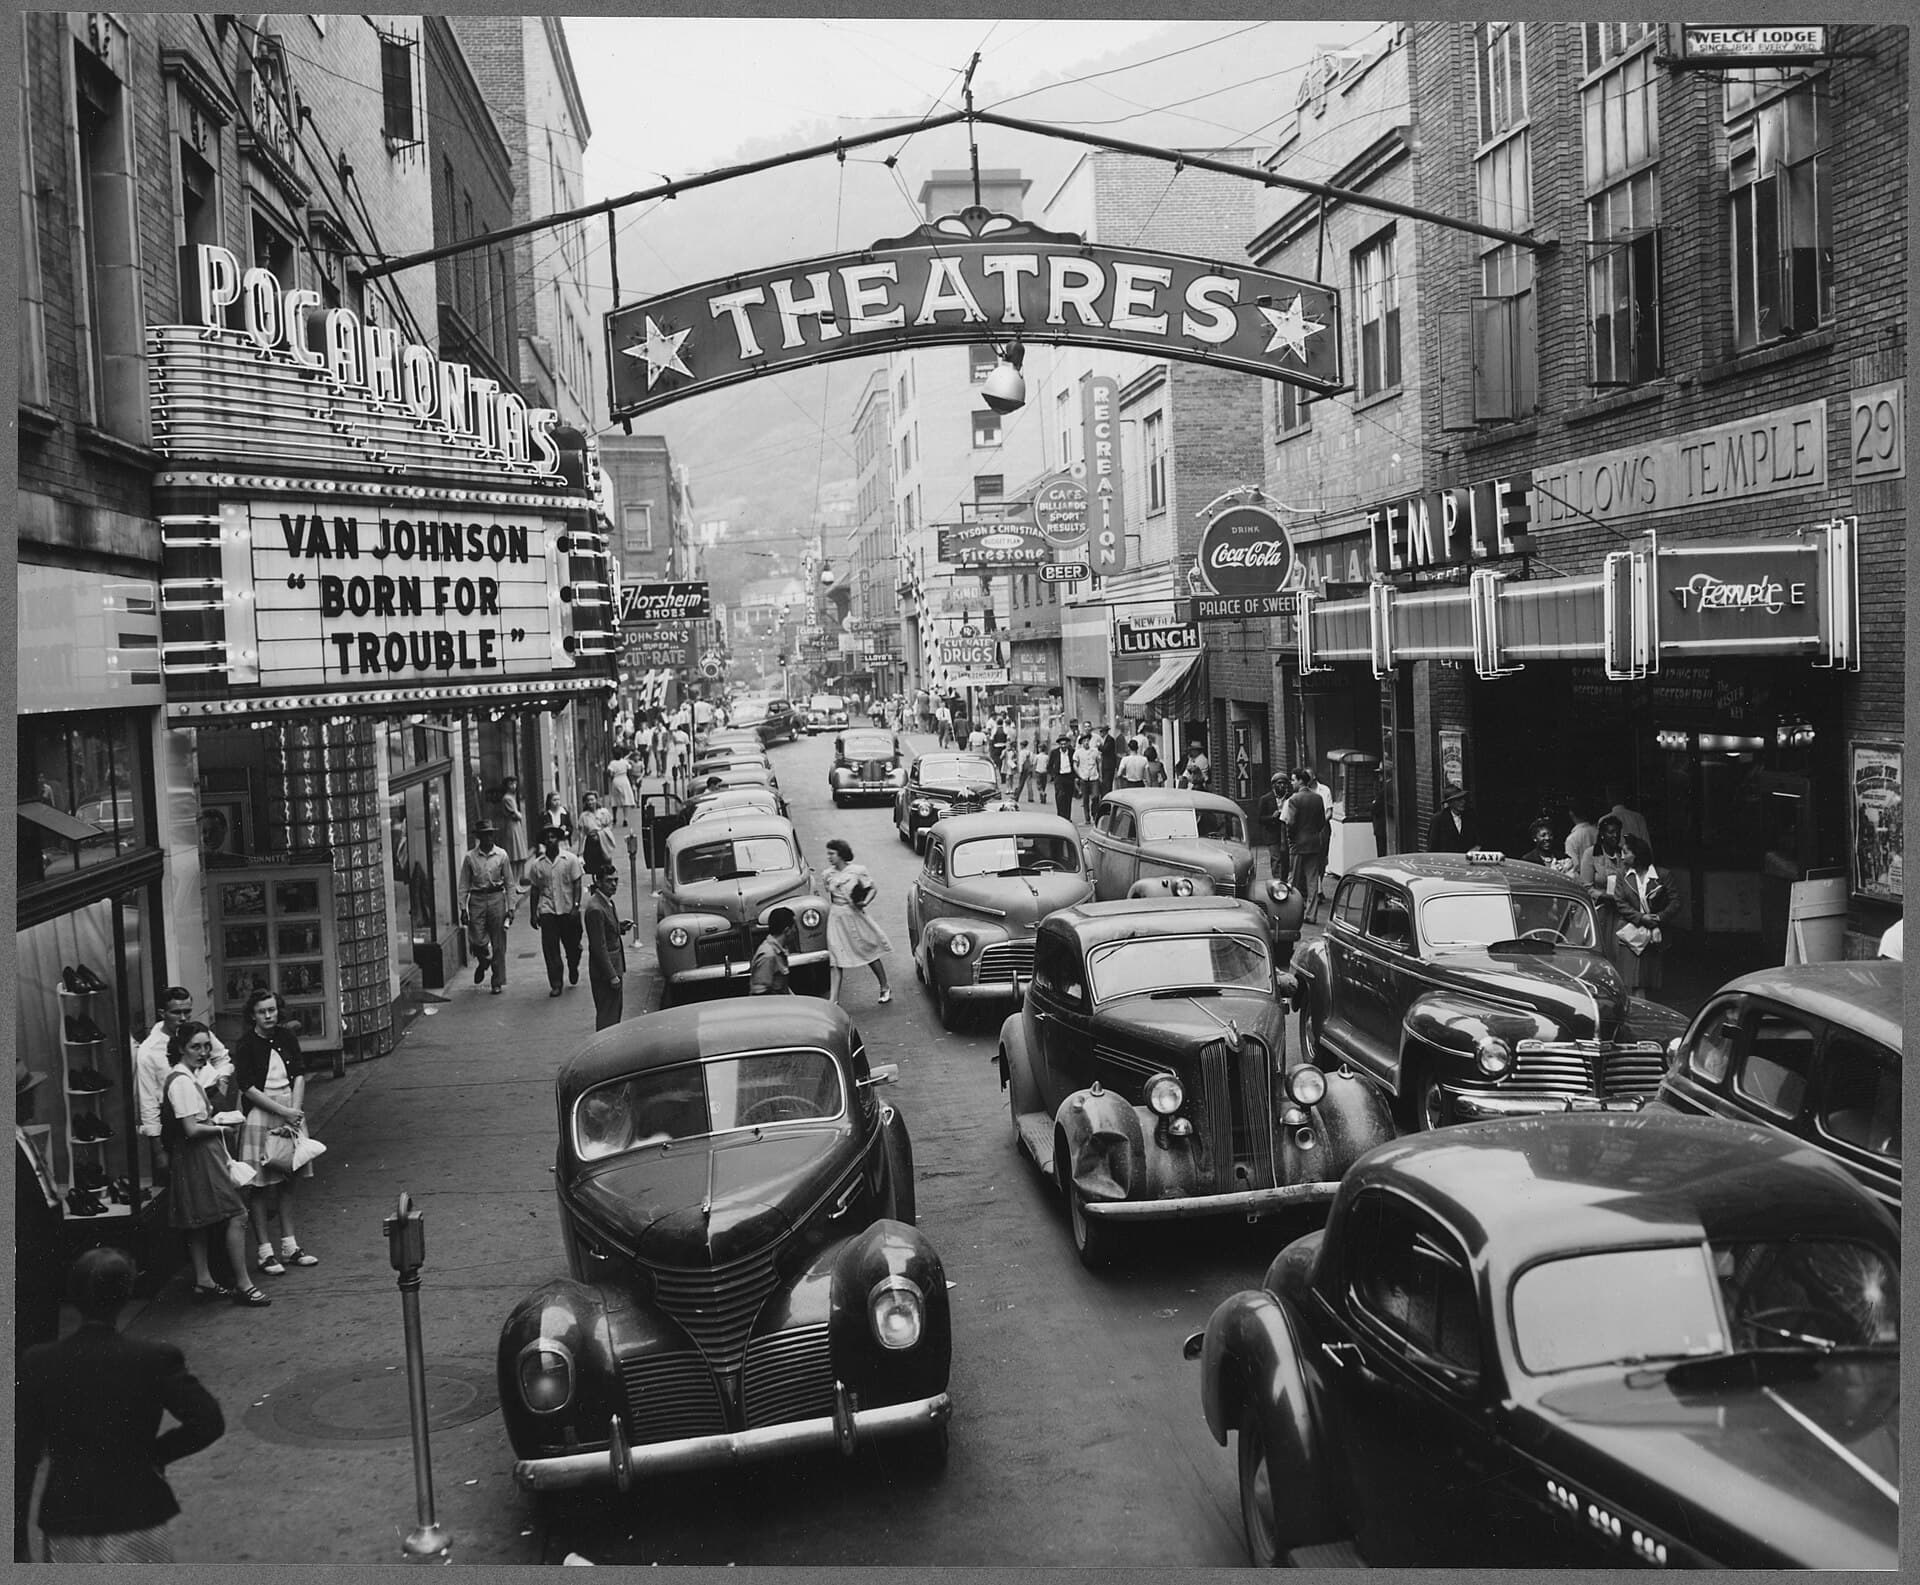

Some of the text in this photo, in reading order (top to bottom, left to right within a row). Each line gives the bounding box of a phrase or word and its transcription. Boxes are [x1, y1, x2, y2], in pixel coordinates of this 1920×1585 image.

[1695, 30, 1817, 43] WELCH LODGE
[1699, 43, 1727, 52] SINCE
[1758, 43, 1788, 51] EVERY
[708, 253, 1241, 360] THEATRES
[196, 243, 562, 478] POCAHONTAS
[1855, 399, 1897, 464] 29
[1093, 386, 1116, 565] RECREATION
[1534, 419, 1817, 525] FELLOWS TEMPLE
[1049, 489, 1082, 501] CAFE
[1039, 501, 1087, 511] BILLIARDS
[958, 524, 1044, 541] TYSON & CHRISTIAN
[1047, 522, 1086, 534] RESULTS
[1231, 525, 1260, 534] DRINK
[1366, 481, 1515, 573] TEMPLE
[279, 513, 529, 564] VAN JOHNSON
[960, 547, 1045, 563] Firestone
[1210, 540, 1283, 569] Coca-Cola
[1046, 566, 1082, 579] BEER
[434, 576, 499, 616] FOR
[621, 585, 702, 620] Florsheim
[861, 572, 870, 623] HOTEL
[644, 607, 686, 619] SHOES
[1199, 597, 1301, 616] PALACE OF SWEET
[1134, 615, 1156, 628] NEW
[621, 630, 689, 646] JOHNSON'S
[945, 638, 963, 647] CUT
[1123, 629, 1196, 651] LUNCH
[624, 649, 686, 667] CUT-RATE
[943, 647, 993, 663] DRUGS
[1235, 728, 1249, 799] TAXI
[1475, 853, 1499, 861] TAXI
